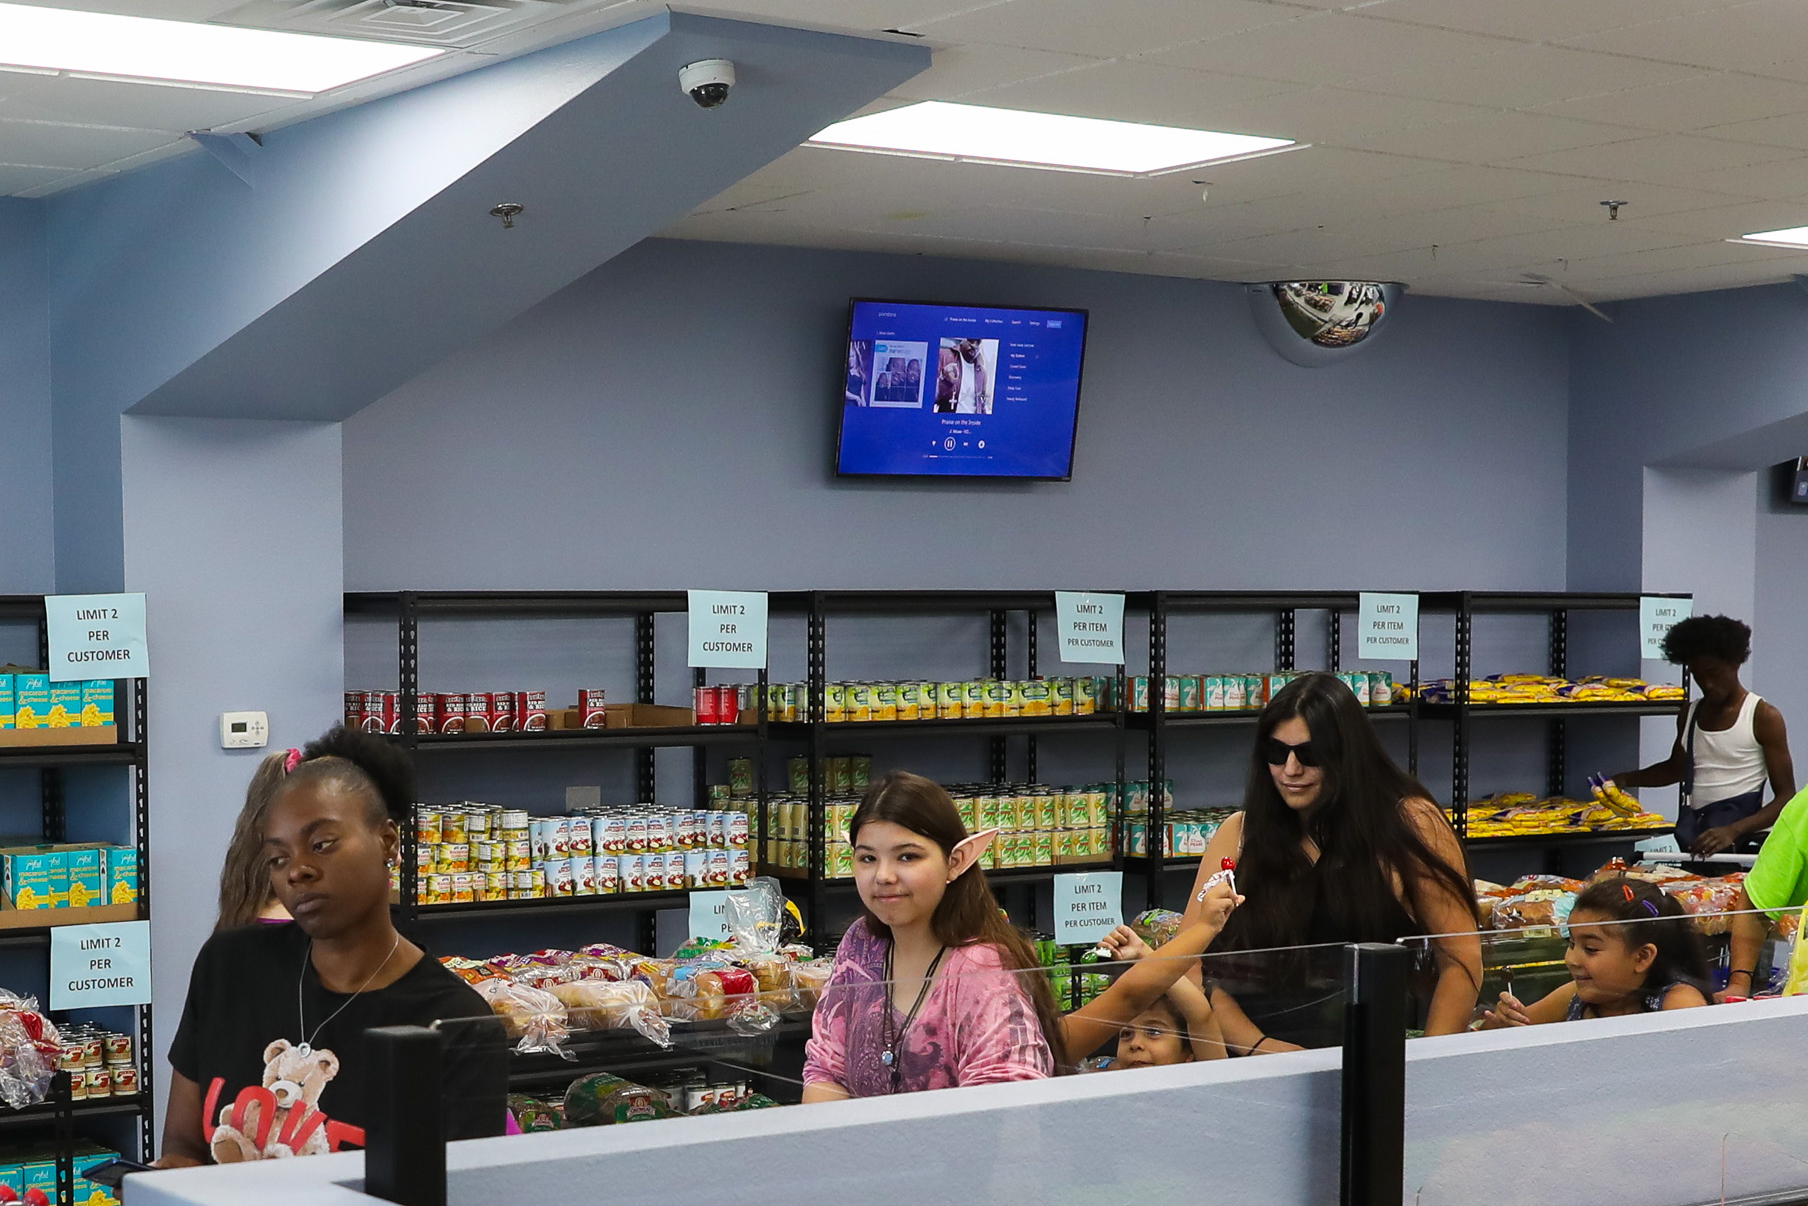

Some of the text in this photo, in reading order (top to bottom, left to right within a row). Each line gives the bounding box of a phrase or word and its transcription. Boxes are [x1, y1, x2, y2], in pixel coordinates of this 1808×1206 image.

[76, 608, 118, 621] LIMIT 2
[712, 604, 746, 615] LIMIT 2
[1076, 604, 1103, 615] LIMIT 2
[1376, 605, 1401, 614] LIMIT 2
[1655, 609, 1677, 617] LIMIT 2
[720, 624, 737, 634] PER
[1073, 622, 1108, 632] PER ITEM
[1372, 621, 1404, 631] PER ITEM
[88, 630, 110, 641] PER
[1366, 636, 1409, 645] PER CUSTOMER
[702, 642, 753, 653] CUSTOMER
[1067, 638, 1114, 648] PER CUSTOMER
[67, 649, 131, 663] CUSTOMER
[1074, 884, 1102, 894] LIMIT 2
[1071, 901, 1107, 912] PER ITEM
[1064, 918, 1115, 928] PER CUSTOMER
[80, 937, 121, 951] LIMIT 2
[89, 959, 112, 970] PER
[68, 977, 134, 991] CUSTOMER
